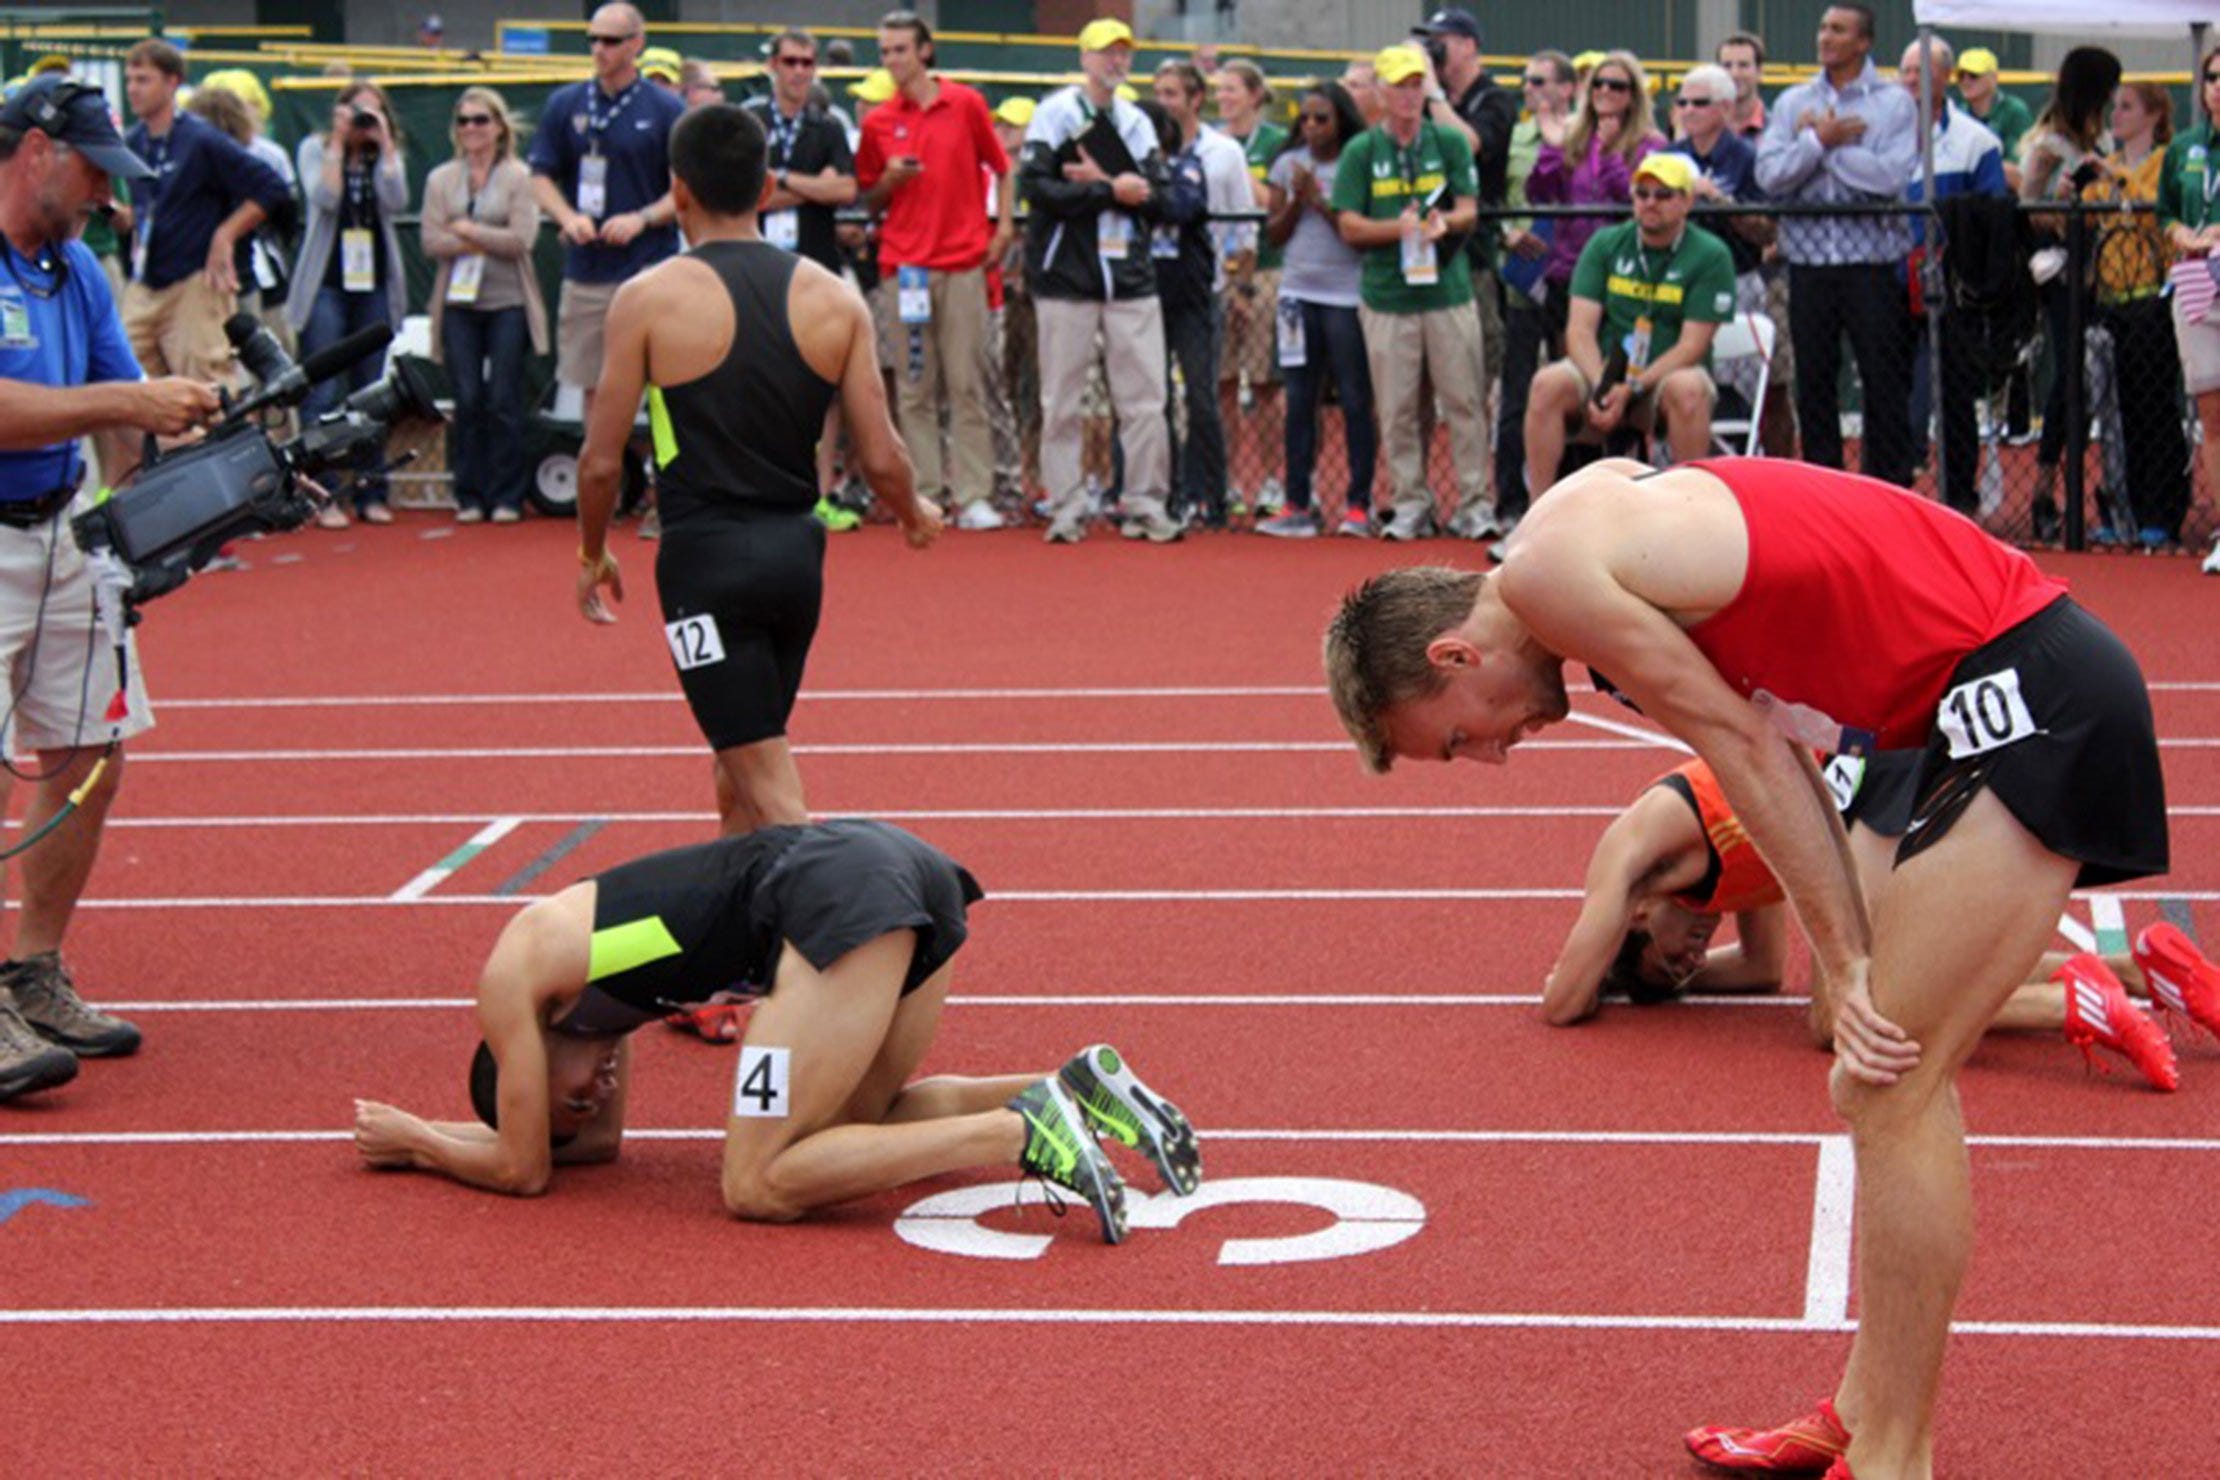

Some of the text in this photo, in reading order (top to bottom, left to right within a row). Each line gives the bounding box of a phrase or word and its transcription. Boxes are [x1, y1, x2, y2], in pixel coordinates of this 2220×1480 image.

[674, 620, 712, 664] 12
[1950, 680, 2013, 749] 10
[741, 1053, 778, 1111] 4
